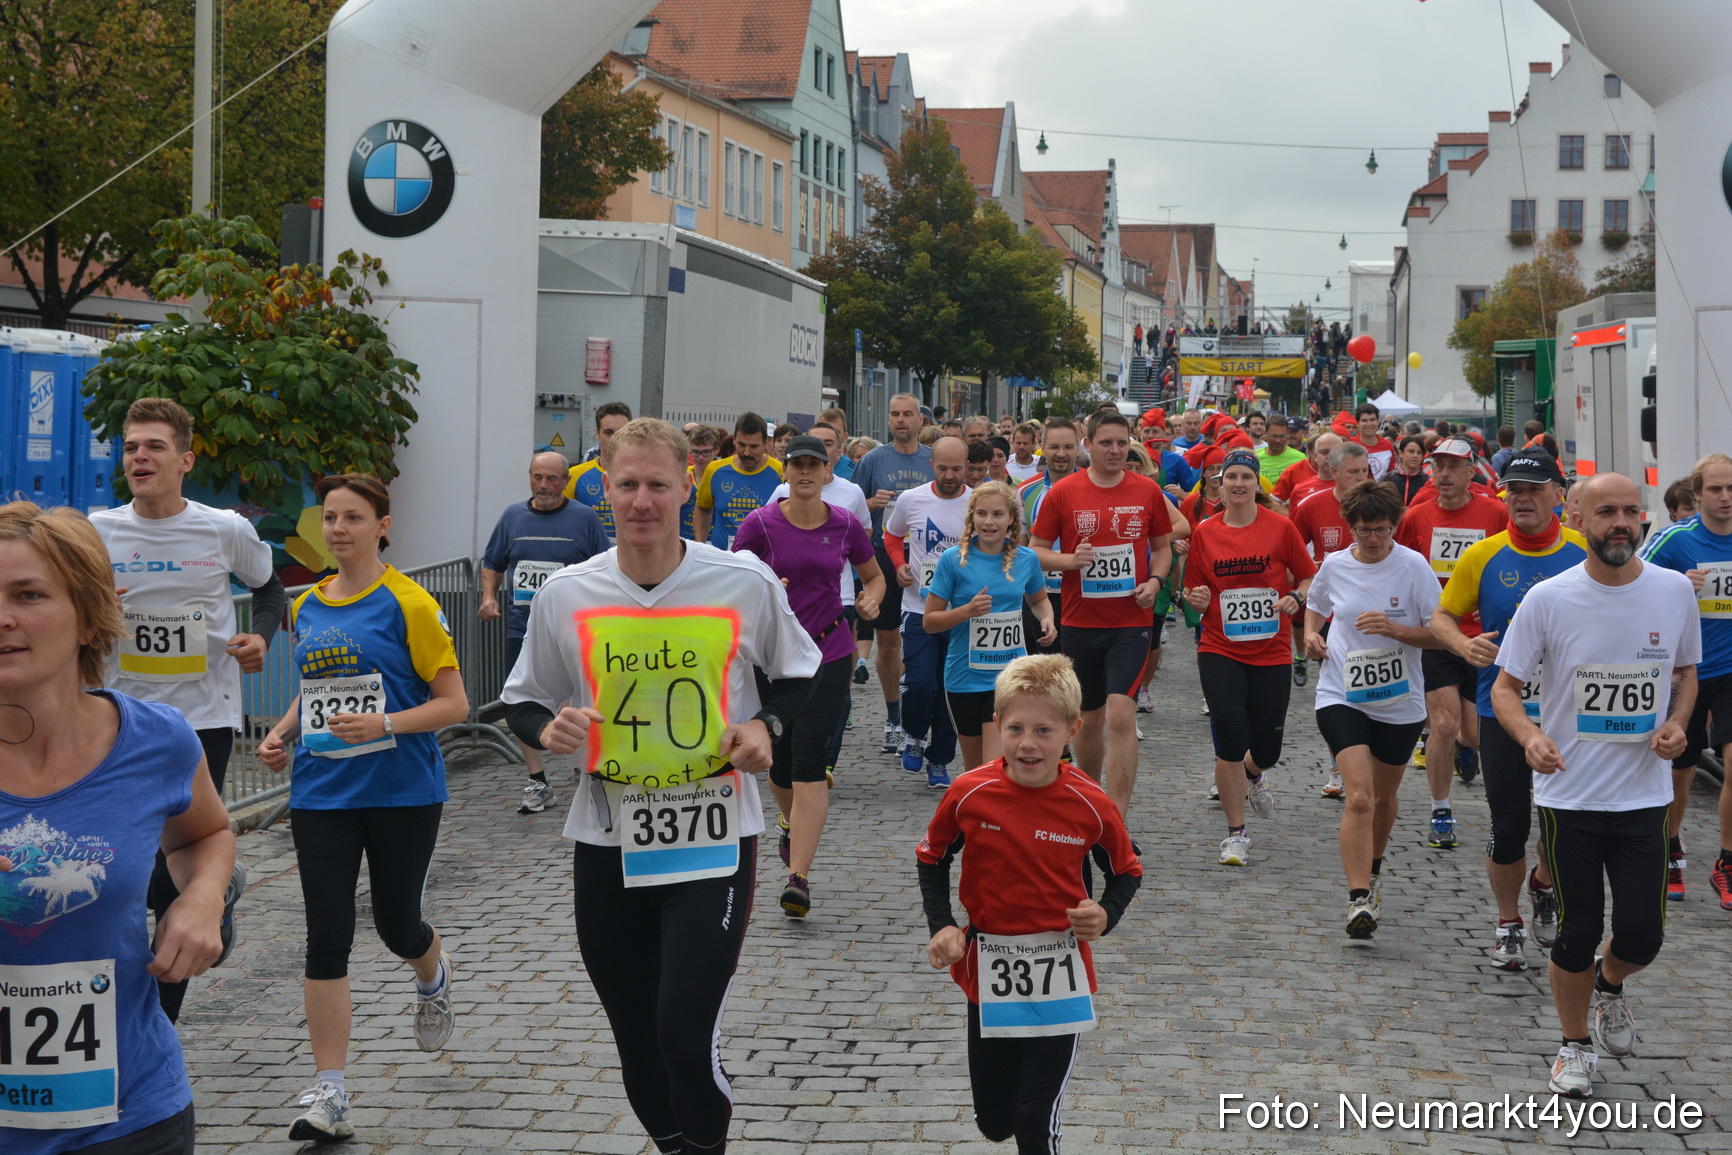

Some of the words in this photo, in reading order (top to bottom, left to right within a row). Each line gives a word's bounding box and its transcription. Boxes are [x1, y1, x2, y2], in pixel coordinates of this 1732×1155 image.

[355, 122, 447, 162] BMW
[789, 323, 819, 368] BOCK
[1220, 361, 1264, 372] START
[1100, 550, 1126, 558] Neumarkt
[181, 558, 216, 568] energie
[1086, 556, 1132, 579] 2394
[1096, 582, 1123, 591] Patrick
[1241, 591, 1269, 599] Neumarkt
[148, 613, 190, 623] Neumarkt
[1226, 598, 1275, 622] 2393
[971, 617, 993, 625] PARTL
[993, 616, 1018, 624] Neumarkt
[976, 624, 1021, 648] 2760
[1241, 625, 1262, 634] Petra
[135, 624, 186, 654] 631
[605, 640, 698, 673] heute
[1344, 655, 1364, 663] PARTL
[1365, 651, 1396, 661] Neumarkt
[1349, 658, 1403, 688] 2650
[1576, 670, 1606, 680] PARTL
[1607, 670, 1649, 680] Neumarkt
[303, 686, 329, 696] PARTL
[330, 683, 368, 693] Neumarkt
[1366, 688, 1392, 701] Maria
[1583, 681, 1656, 712] 2769
[612, 677, 707, 752] 40
[1605, 719, 1637, 732] Peter
[622, 793, 660, 805] PARTL
[662, 788, 717, 803] Neumarkt
[632, 802, 728, 846] 3370
[1035, 829, 1048, 840] FC
[1049, 832, 1086, 846] Holzheim
[38, 841, 115, 865] Place
[980, 943, 1014, 955] PARTL
[1016, 940, 1067, 954] Neumarkt
[991, 953, 1077, 997] 3371
[0, 980, 83, 998] Neumarkt
